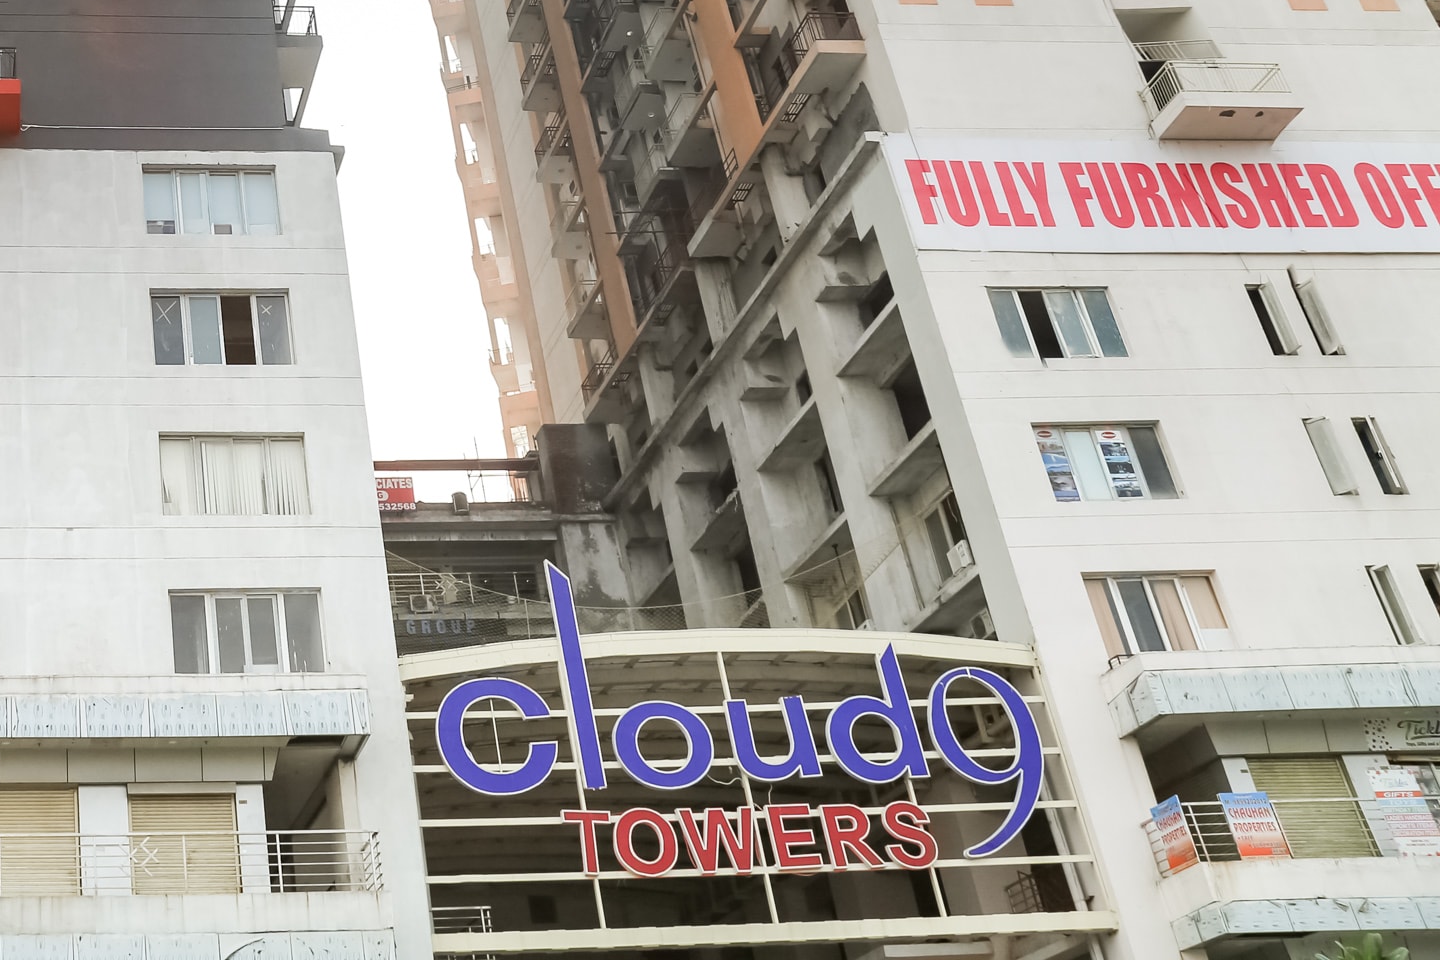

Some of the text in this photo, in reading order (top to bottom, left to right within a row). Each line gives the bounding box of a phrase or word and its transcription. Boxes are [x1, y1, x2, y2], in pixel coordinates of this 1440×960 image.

[904, 158, 1440, 230] FULLY FURNISHED OFF
[405, 619, 476, 635] GROUP
[1227, 807, 1271, 819] CHAUHAN
[1232, 821, 1277, 833] PROPERTIES
[560, 800, 939, 877] TOWERS
